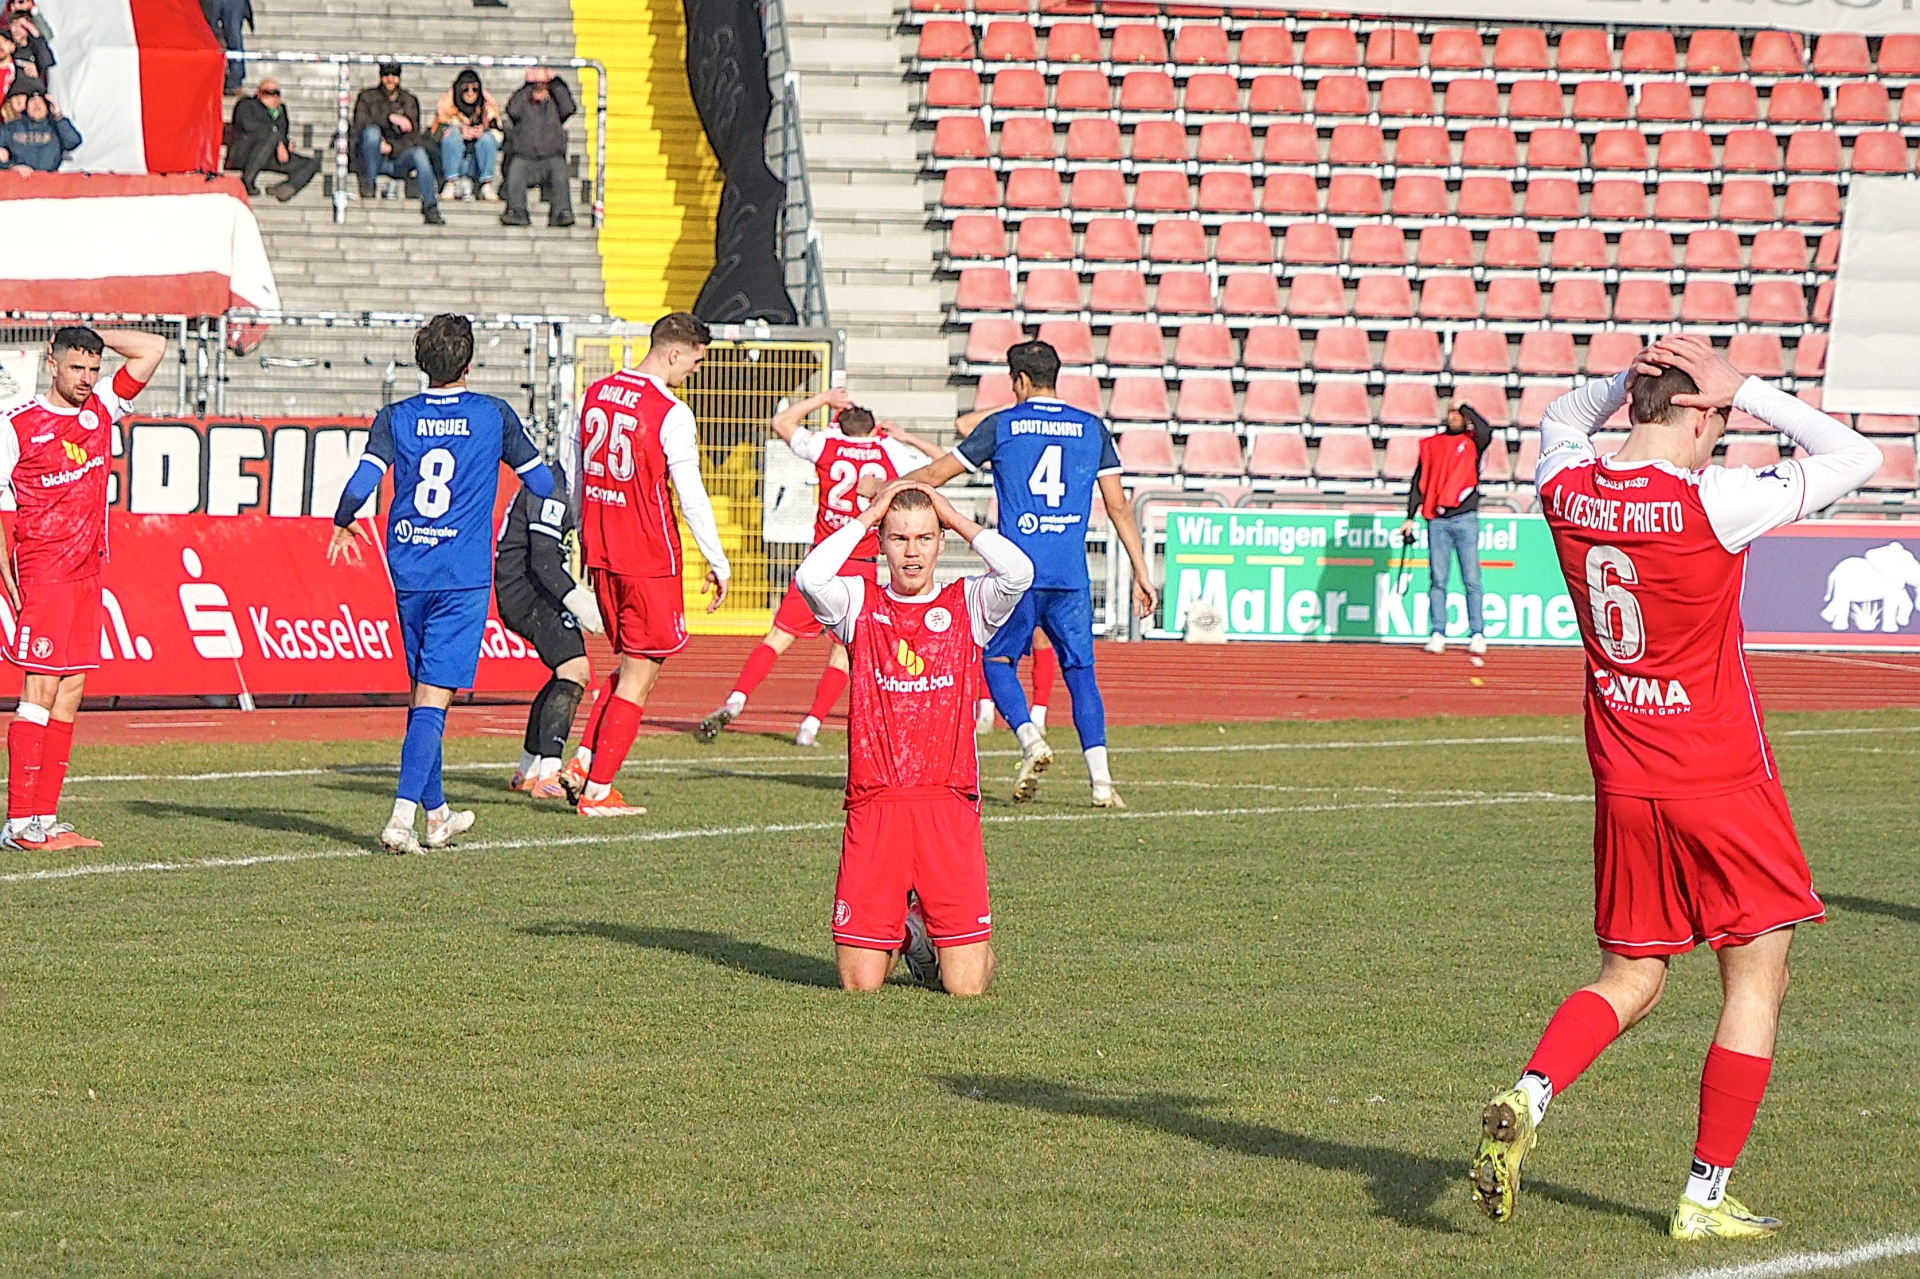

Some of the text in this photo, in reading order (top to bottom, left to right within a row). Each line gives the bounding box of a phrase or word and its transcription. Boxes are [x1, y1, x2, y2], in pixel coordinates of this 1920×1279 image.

[597, 384, 642, 409] DAHLKE
[416, 418, 470, 437] AYGUEL
[583, 406, 638, 482] 25
[1011, 419, 1083, 437] BOUTAKHRIT
[413, 448, 456, 518] 8
[1028, 445, 1066, 508] 4
[1177, 516, 1223, 545] Wir
[1229, 515, 1327, 554] bringen
[1333, 518, 1403, 549] Farbe
[1564, 491, 1621, 532] LIESCHE
[1623, 501, 1683, 533] PRIETO
[1586, 545, 1645, 664] 6
[248, 604, 393, 659] Kasseler
